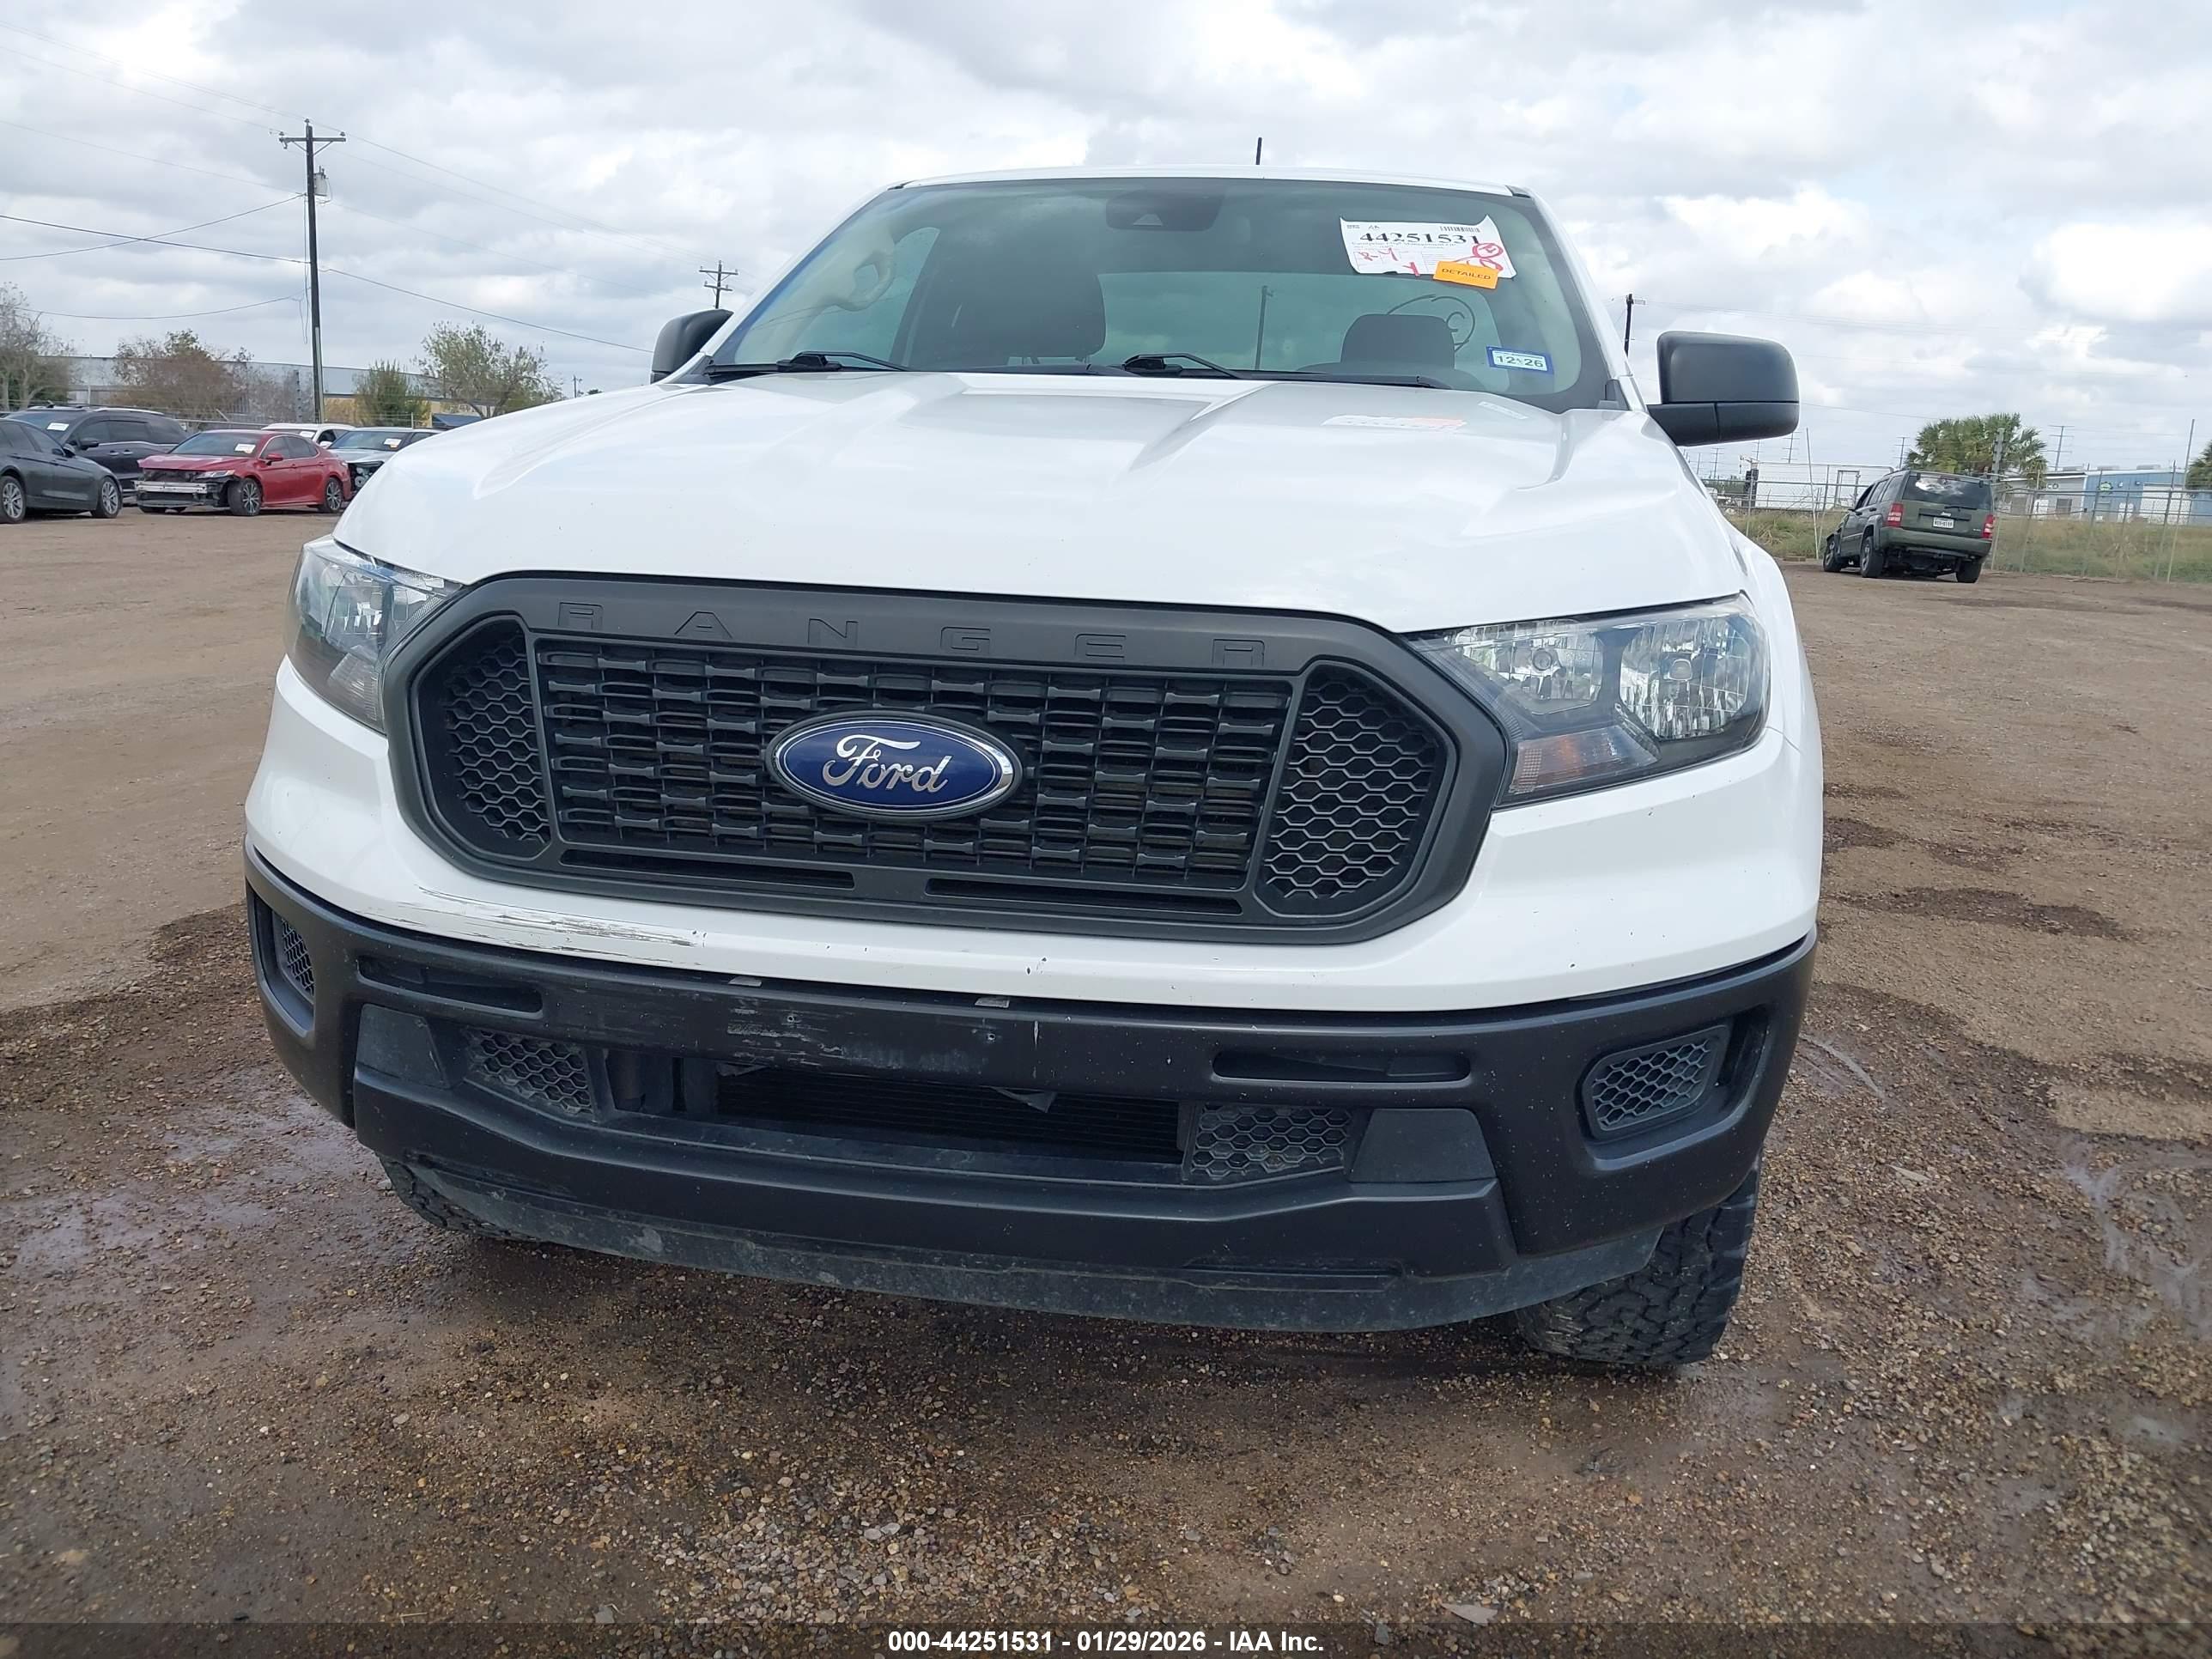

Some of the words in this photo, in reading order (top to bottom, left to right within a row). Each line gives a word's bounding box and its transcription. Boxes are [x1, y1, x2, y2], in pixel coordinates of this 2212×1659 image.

[1359, 232, 1480, 245] 44251531
[1441, 268, 1492, 280] DETAILED
[556, 600, 1267, 667] RANGER
[821, 734, 953, 793] Ford
